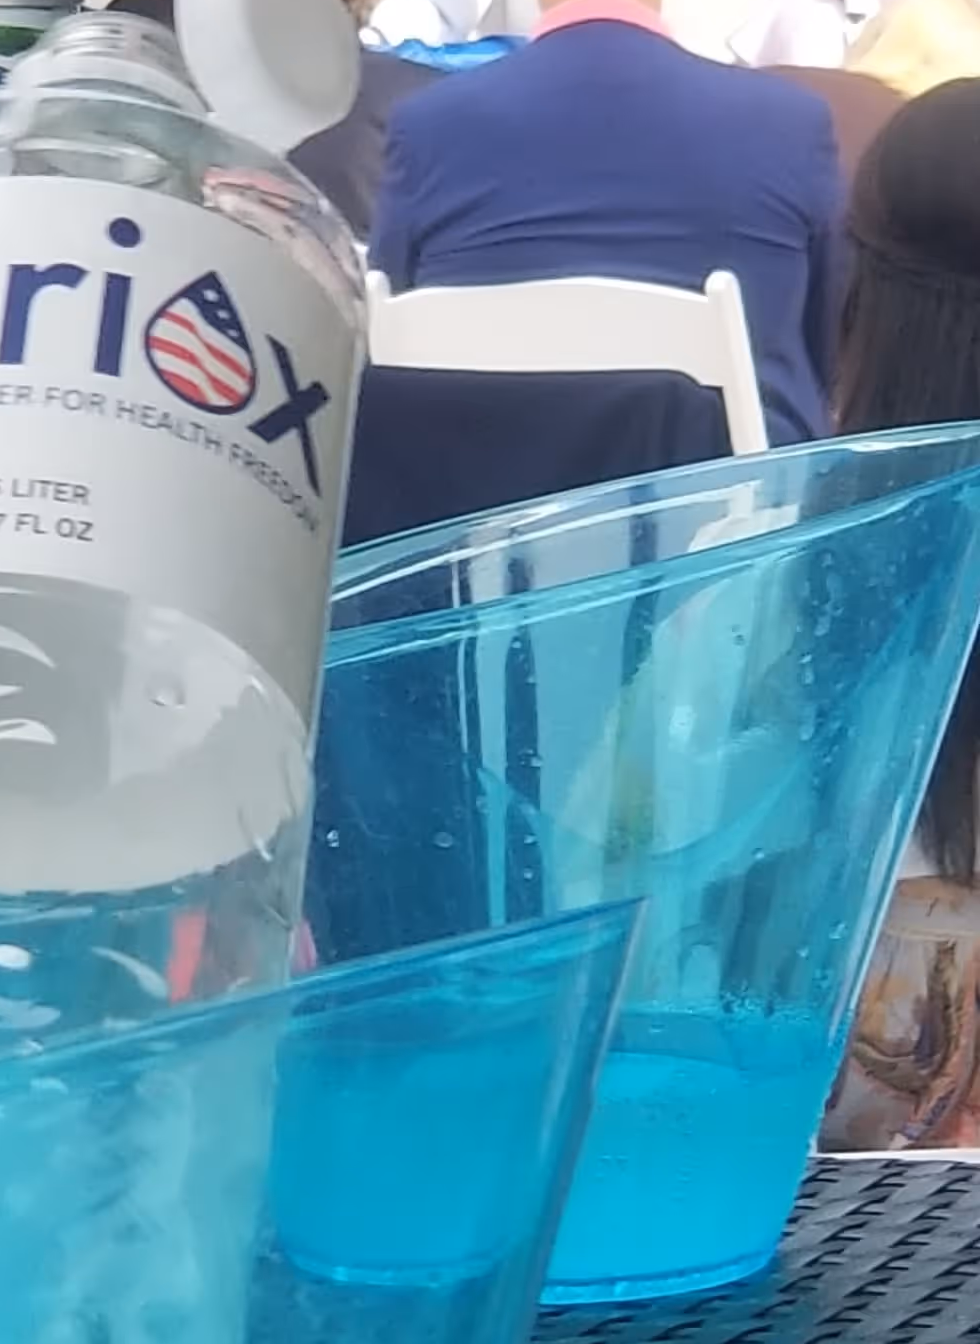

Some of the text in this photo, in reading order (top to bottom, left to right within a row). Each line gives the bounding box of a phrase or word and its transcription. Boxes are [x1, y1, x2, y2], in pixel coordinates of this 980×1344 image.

[45, 386, 107, 416] FOR
[116, 400, 223, 456] HEALTH
[11, 477, 91, 506] LITER
[15, 513, 48, 535] FL
[55, 517, 95, 543] OZ
